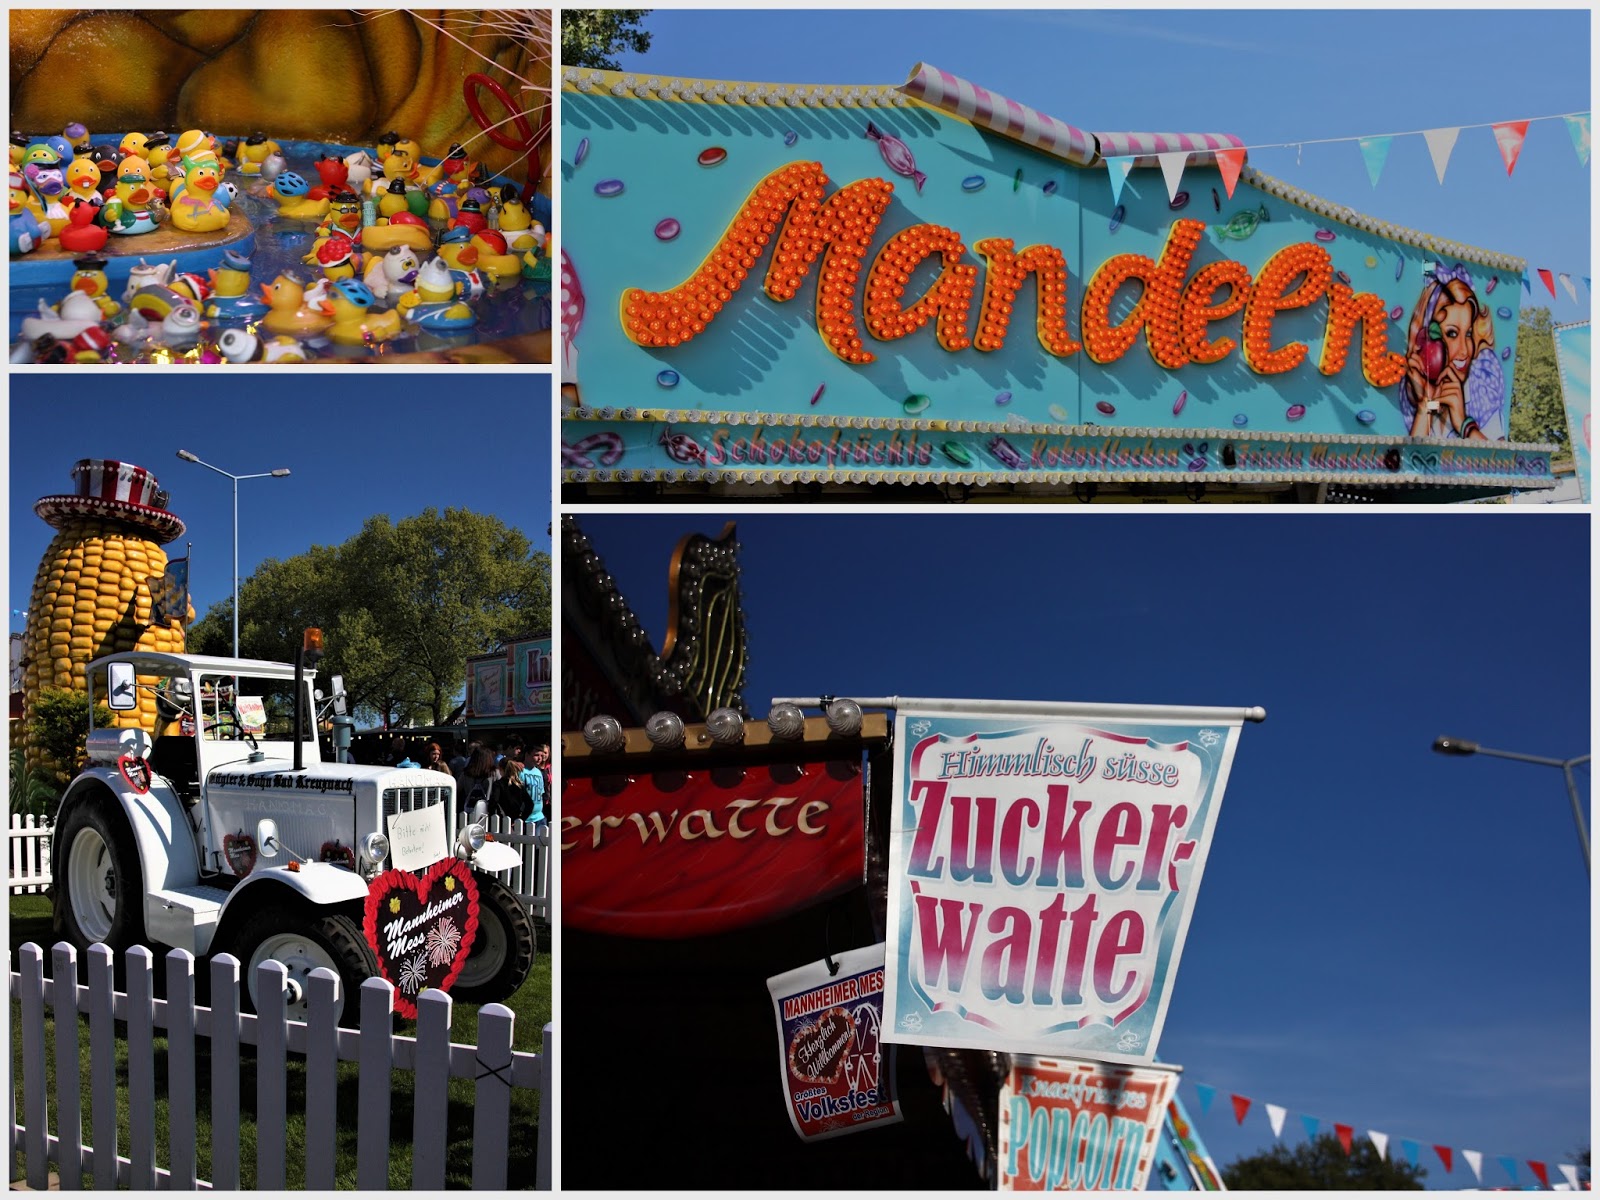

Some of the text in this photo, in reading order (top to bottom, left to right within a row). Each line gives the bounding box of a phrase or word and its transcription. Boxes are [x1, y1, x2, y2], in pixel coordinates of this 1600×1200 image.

[709, 428, 933, 470] Schokofrüchte
[527, 649, 552, 685] Kn
[938, 737, 1179, 786] Himmlisch süsse
[238, 774, 246, 787] &
[273, 773, 293, 788] Bad
[295, 774, 354, 795] Kreuznach
[397, 825, 416, 840] Bitte
[561, 796, 830, 850] erwatte
[907, 780, 1196, 891] Zucker-
[383, 891, 464, 941] Mannheimer
[386, 932, 426, 960] Mess
[915, 893, 1145, 1006] watte
[785, 979, 858, 1019] MANNHEIMER
[798, 1017, 837, 1063] Herzlich
[807, 1021, 852, 1078] Willkommen!
[795, 1088, 825, 1100] Größtes
[797, 1084, 886, 1120] Volksfest
[1020, 1072, 1147, 1110] Knackfrisches
[865, 1107, 889, 1117] Region
[1006, 1095, 1147, 1191] Popcorn
